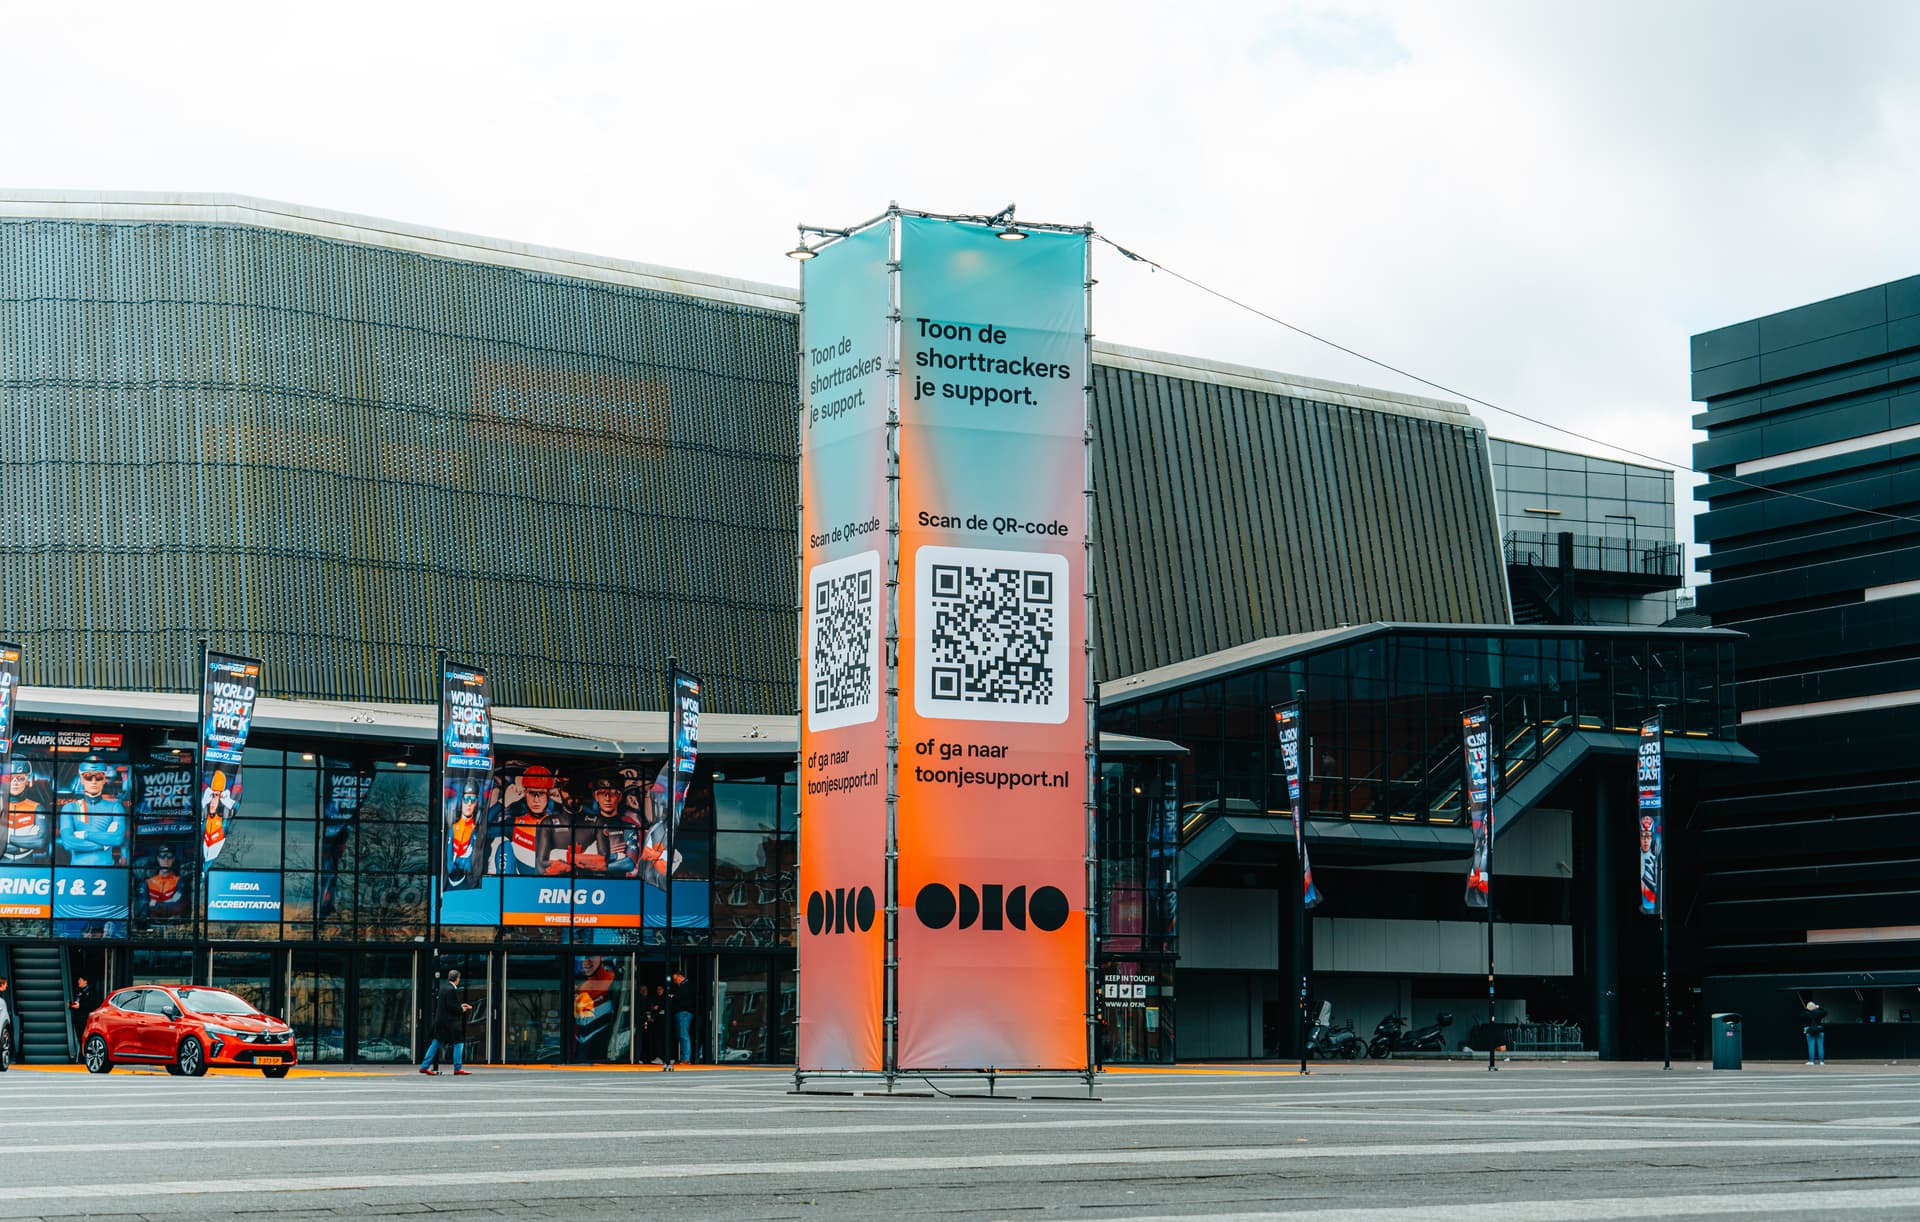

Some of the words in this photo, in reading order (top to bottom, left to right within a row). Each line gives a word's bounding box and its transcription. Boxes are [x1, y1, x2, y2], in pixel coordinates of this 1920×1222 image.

[917, 318, 971, 341] Toon
[978, 324, 1007, 344] de
[811, 345, 835, 367] Toon
[838, 336, 851, 356] de
[916, 348, 1070, 379] shorttrackers
[810, 356, 882, 395] shorttrackers
[914, 376, 935, 400] je
[942, 383, 1038, 407] support.
[809, 404, 819, 429] je
[821, 388, 865, 420] support.
[810, 534, 830, 549] Scan
[832, 527, 842, 543] de
[843, 515, 880, 542] QR-code
[918, 511, 961, 529] Scan
[966, 515, 988, 530] de
[993, 517, 1069, 536] QR-code
[214, 681, 255, 701] WORLD
[451, 690, 484, 708] WORLD
[213, 697, 253, 717] SHORT
[452, 705, 486, 723] SHORT
[213, 713, 250, 731] TRACK
[454, 720, 489, 737] TRACK
[915, 738, 935, 755] of
[939, 743, 962, 760] ga
[968, 744, 1009, 758] naar
[808, 752, 817, 768] of
[818, 754, 828, 771] ga
[830, 750, 849, 765] naar
[144, 771, 191, 785] WORLD
[808, 768, 878, 796] toonjesupport.nl
[915, 766, 1069, 789] toonjesupport.nl
[144, 784, 192, 797] SHORT
[145, 796, 192, 808] TRACK
[0, 878, 50, 895] RING
[56, 879, 66, 895] 1
[70, 879, 87, 896] &
[92, 879, 107, 896] 2
[229, 883, 259, 891] MEDIA
[538, 888, 588, 905] RING
[0, 907, 40, 915] UNTEERS
[209, 901, 280, 910] ACCREDITATION
